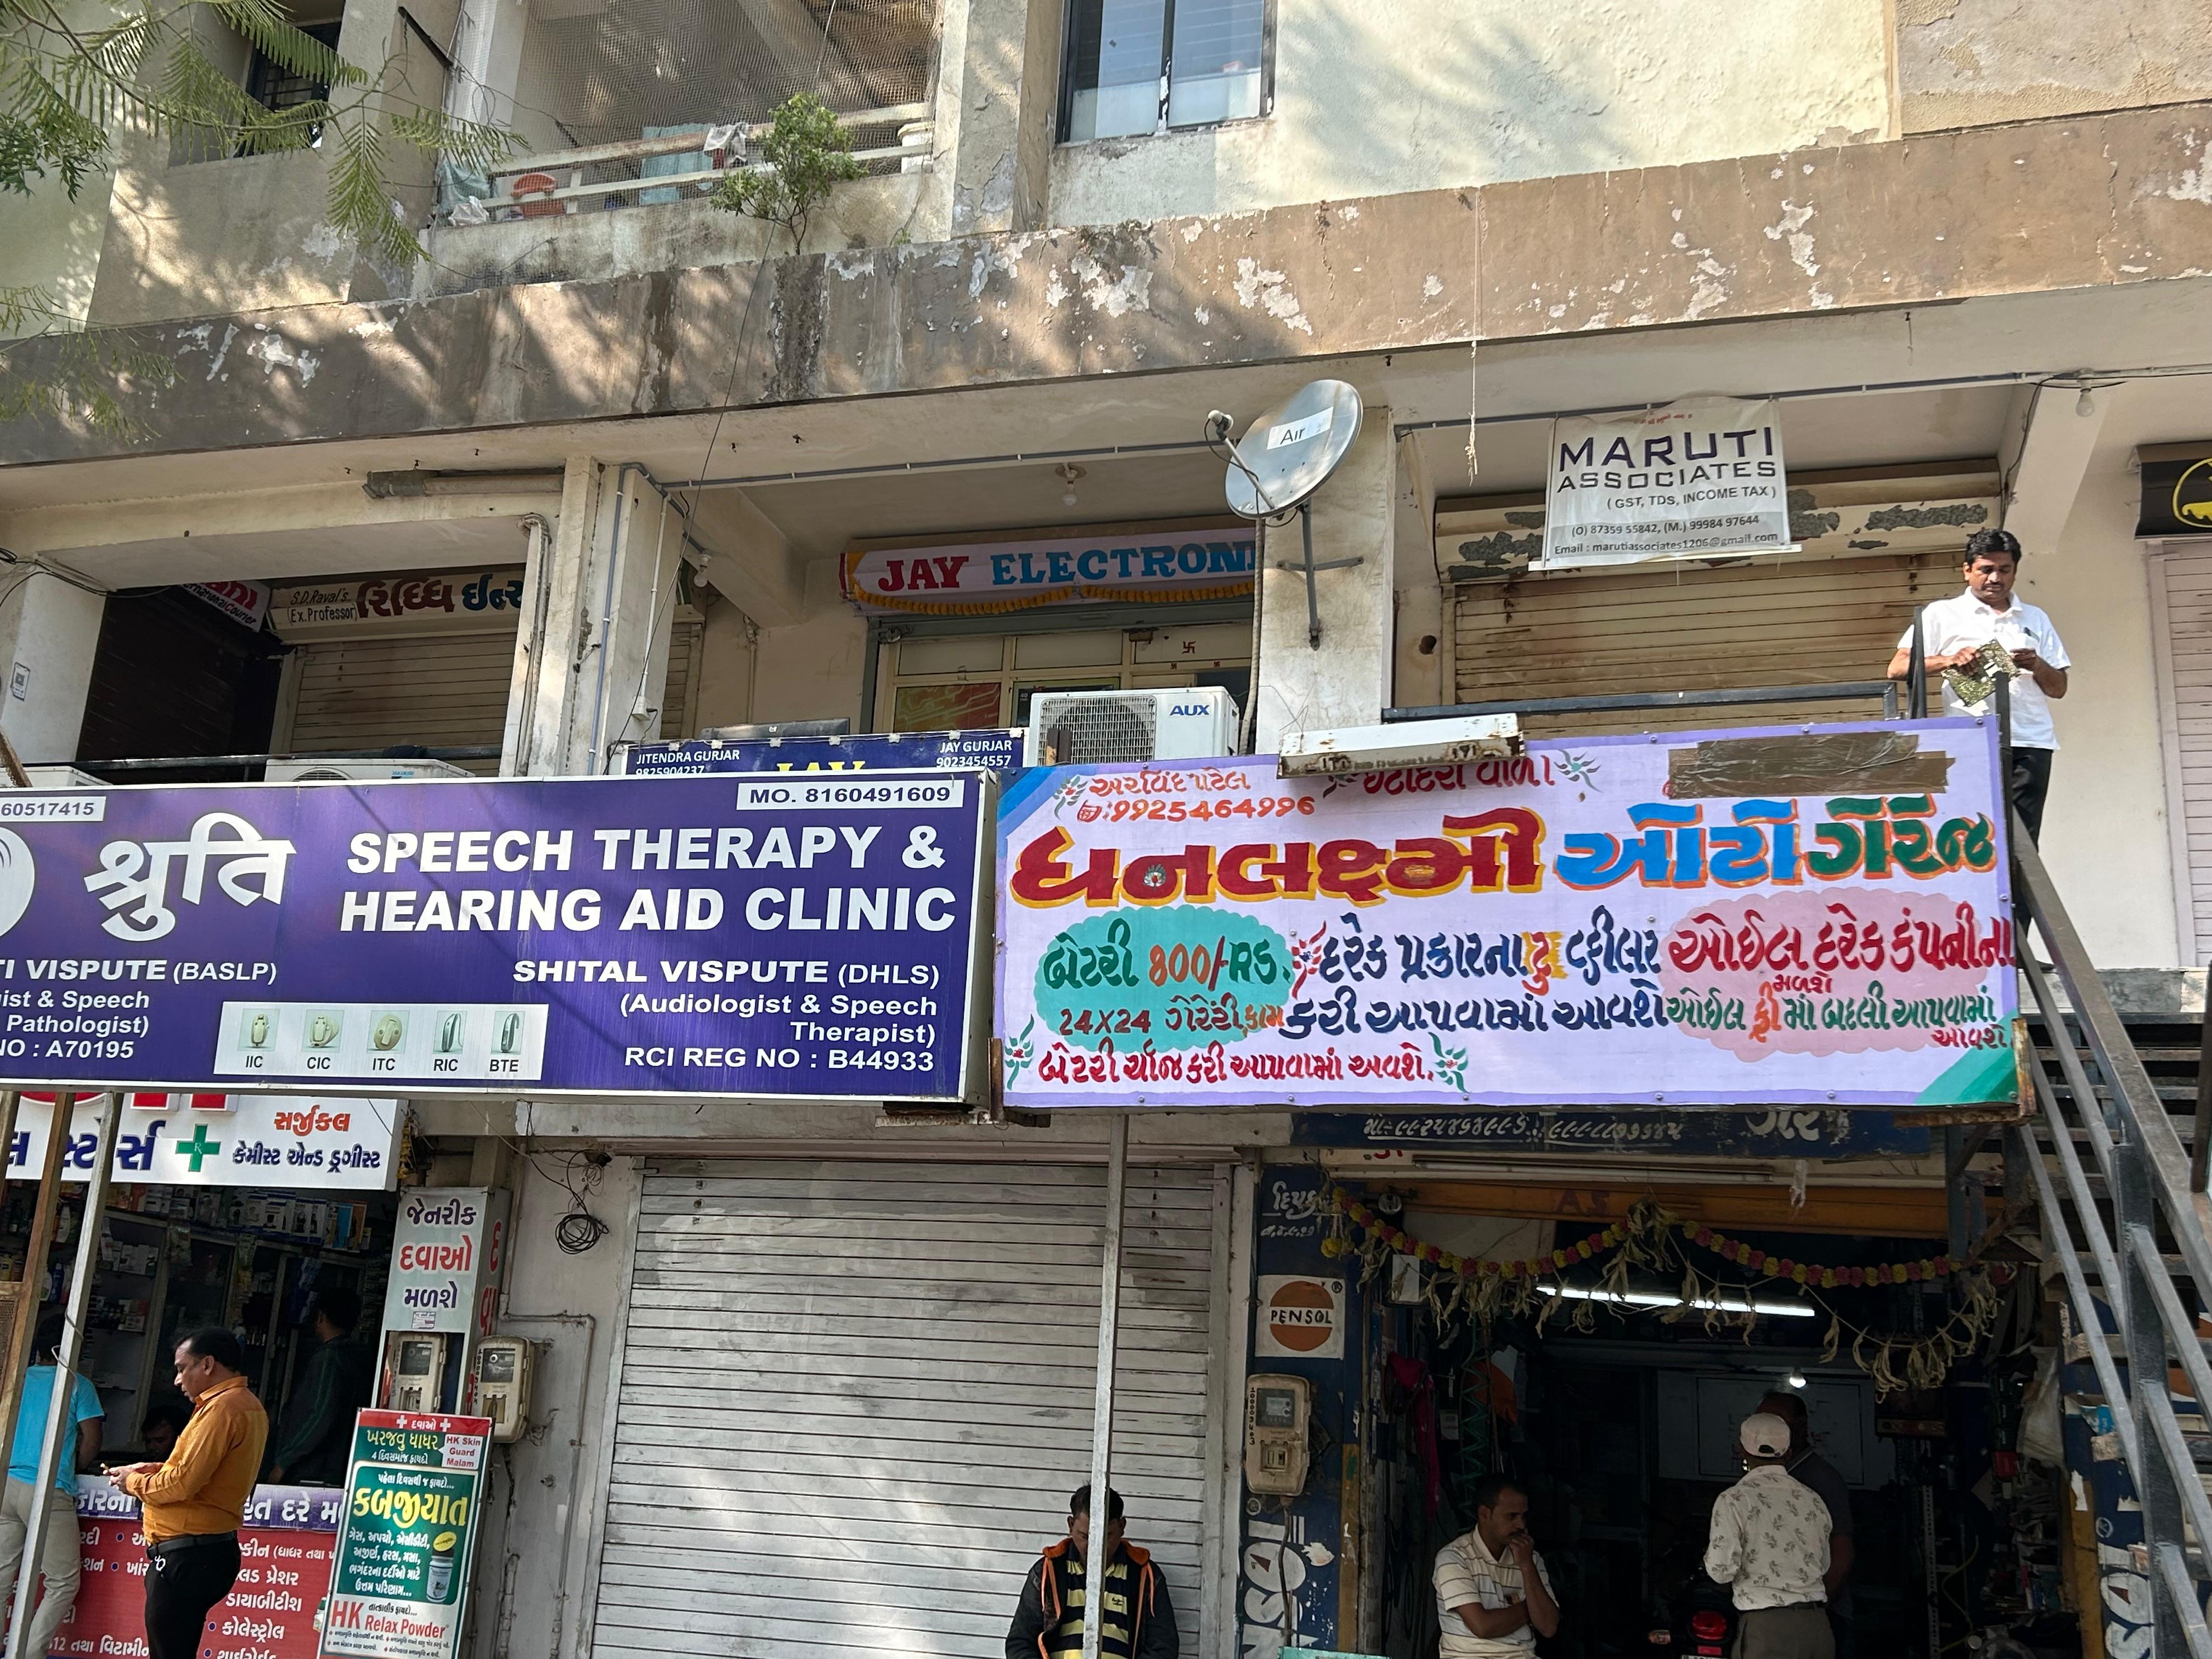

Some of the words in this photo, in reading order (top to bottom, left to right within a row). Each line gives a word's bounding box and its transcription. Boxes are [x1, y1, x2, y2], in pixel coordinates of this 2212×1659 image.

[1280, 427, 1305, 445] Air
[1559, 427, 1773, 472] MARUTI
[1557, 461, 1775, 493] ASSOCIATES
[1649, 495, 1680, 507] TDS,
[1683, 487, 1737, 504] INCOME
[1571, 526, 1587, 537] (O)
[1591, 524, 1622, 535] 87359
[1626, 523, 1661, 534] 55842,
[1664, 521, 1686, 534] (M.)
[1689, 518, 1723, 531] 99984
[1725, 515, 1759, 527] 97644
[1555, 544, 1584, 555] Email
[878, 555, 969, 592] JAY
[1169, 705, 1209, 716] AUX
[636, 753, 692, 765] JITENDRA
[693, 750, 740, 763] GURJAR
[940, 742, 961, 753] JAY
[962, 740, 1012, 752] GURJAR
[936, 755, 1012, 768] 9023454557
[1089, 769, 1188, 797] અરવિંદ
[1187, 766, 1250, 791] પટેલ
[749, 789, 797, 804] MO.
[805, 787, 951, 803] 8160491609
[1, 802, 94, 816] 60517415
[347, 830, 573, 873] SPEECH
[594, 826, 882, 871] THERAPY
[902, 826, 946, 869] &
[1010, 806, 1545, 908] ધનલક્ષ્મી
[84, 812, 296, 941] श्रुति
[340, 889, 601, 932] HEARING
[618, 888, 724, 930] AID
[746, 887, 956, 932] CLINIC
[1321, 912, 1389, 983] દરેક
[26, 960, 167, 980] VISPUTE
[173, 962, 277, 985] (BASLP)
[514, 961, 647, 983] SHITAL
[661, 961, 828, 983] VISPUTE
[838, 964, 939, 989] (DHLS)
[37, 990, 54, 1007] &
[62, 990, 149, 1012] Speech
[620, 994, 792, 1018] (Audiologist
[800, 995, 821, 1013] &
[831, 995, 936, 1019] Speech
[1278, 985, 1361, 1039] કરી
[1367, 994, 1548, 1032] આપવામાં
[1551, 978, 1668, 1030] આવશે
[1821, 980, 1890, 1030] બદલી
[1891, 985, 1997, 1029] આપવામાં
[7, 1014, 149, 1038] Pathologist)
[1060, 1008, 1151, 1035] 24X24
[790, 1022, 936, 1048] Therapist)
[45, 1040, 134, 1058] A70195
[624, 1047, 674, 1066] RCI
[684, 1048, 747, 1068] REG
[756, 1049, 800, 1069] NO
[828, 1050, 934, 1071] B44933
[245, 1056, 263, 1068] IIC
[307, 1057, 331, 1070] CIC
[373, 1058, 395, 1071] ITC
[433, 1059, 458, 1071] RIC
[489, 1060, 519, 1073] BTE
[274, 1104, 351, 1136] સર્જીકલ
[407, 1198, 477, 1226] જેનરીક
[399, 1235, 472, 1271] દવાઓ
[404, 1281, 458, 1308] મળશે
[1271, 1310, 1333, 1324] PENSOL
[411, 1418, 436, 1430] દવાઓ
[447, 1436, 459, 1444] HK
[462, 1437, 481, 1446] Skin
[449, 1447, 475, 1456] Guard
[447, 1458, 474, 1467] Malam
[282, 1491, 311, 1522] દરે
[352, 1487, 468, 1529] કબજીયાત
[306, 1549, 325, 1560] તથા
[266, 1564, 299, 1585] પ્રેશર
[225, 1589, 302, 1612] ડાયાબીટીશ
[331, 1600, 364, 1630] HK
[365, 1615, 399, 1634] Relax
[400, 1618, 447, 1639] Powder
[70, 1639, 93, 1653] તથા
